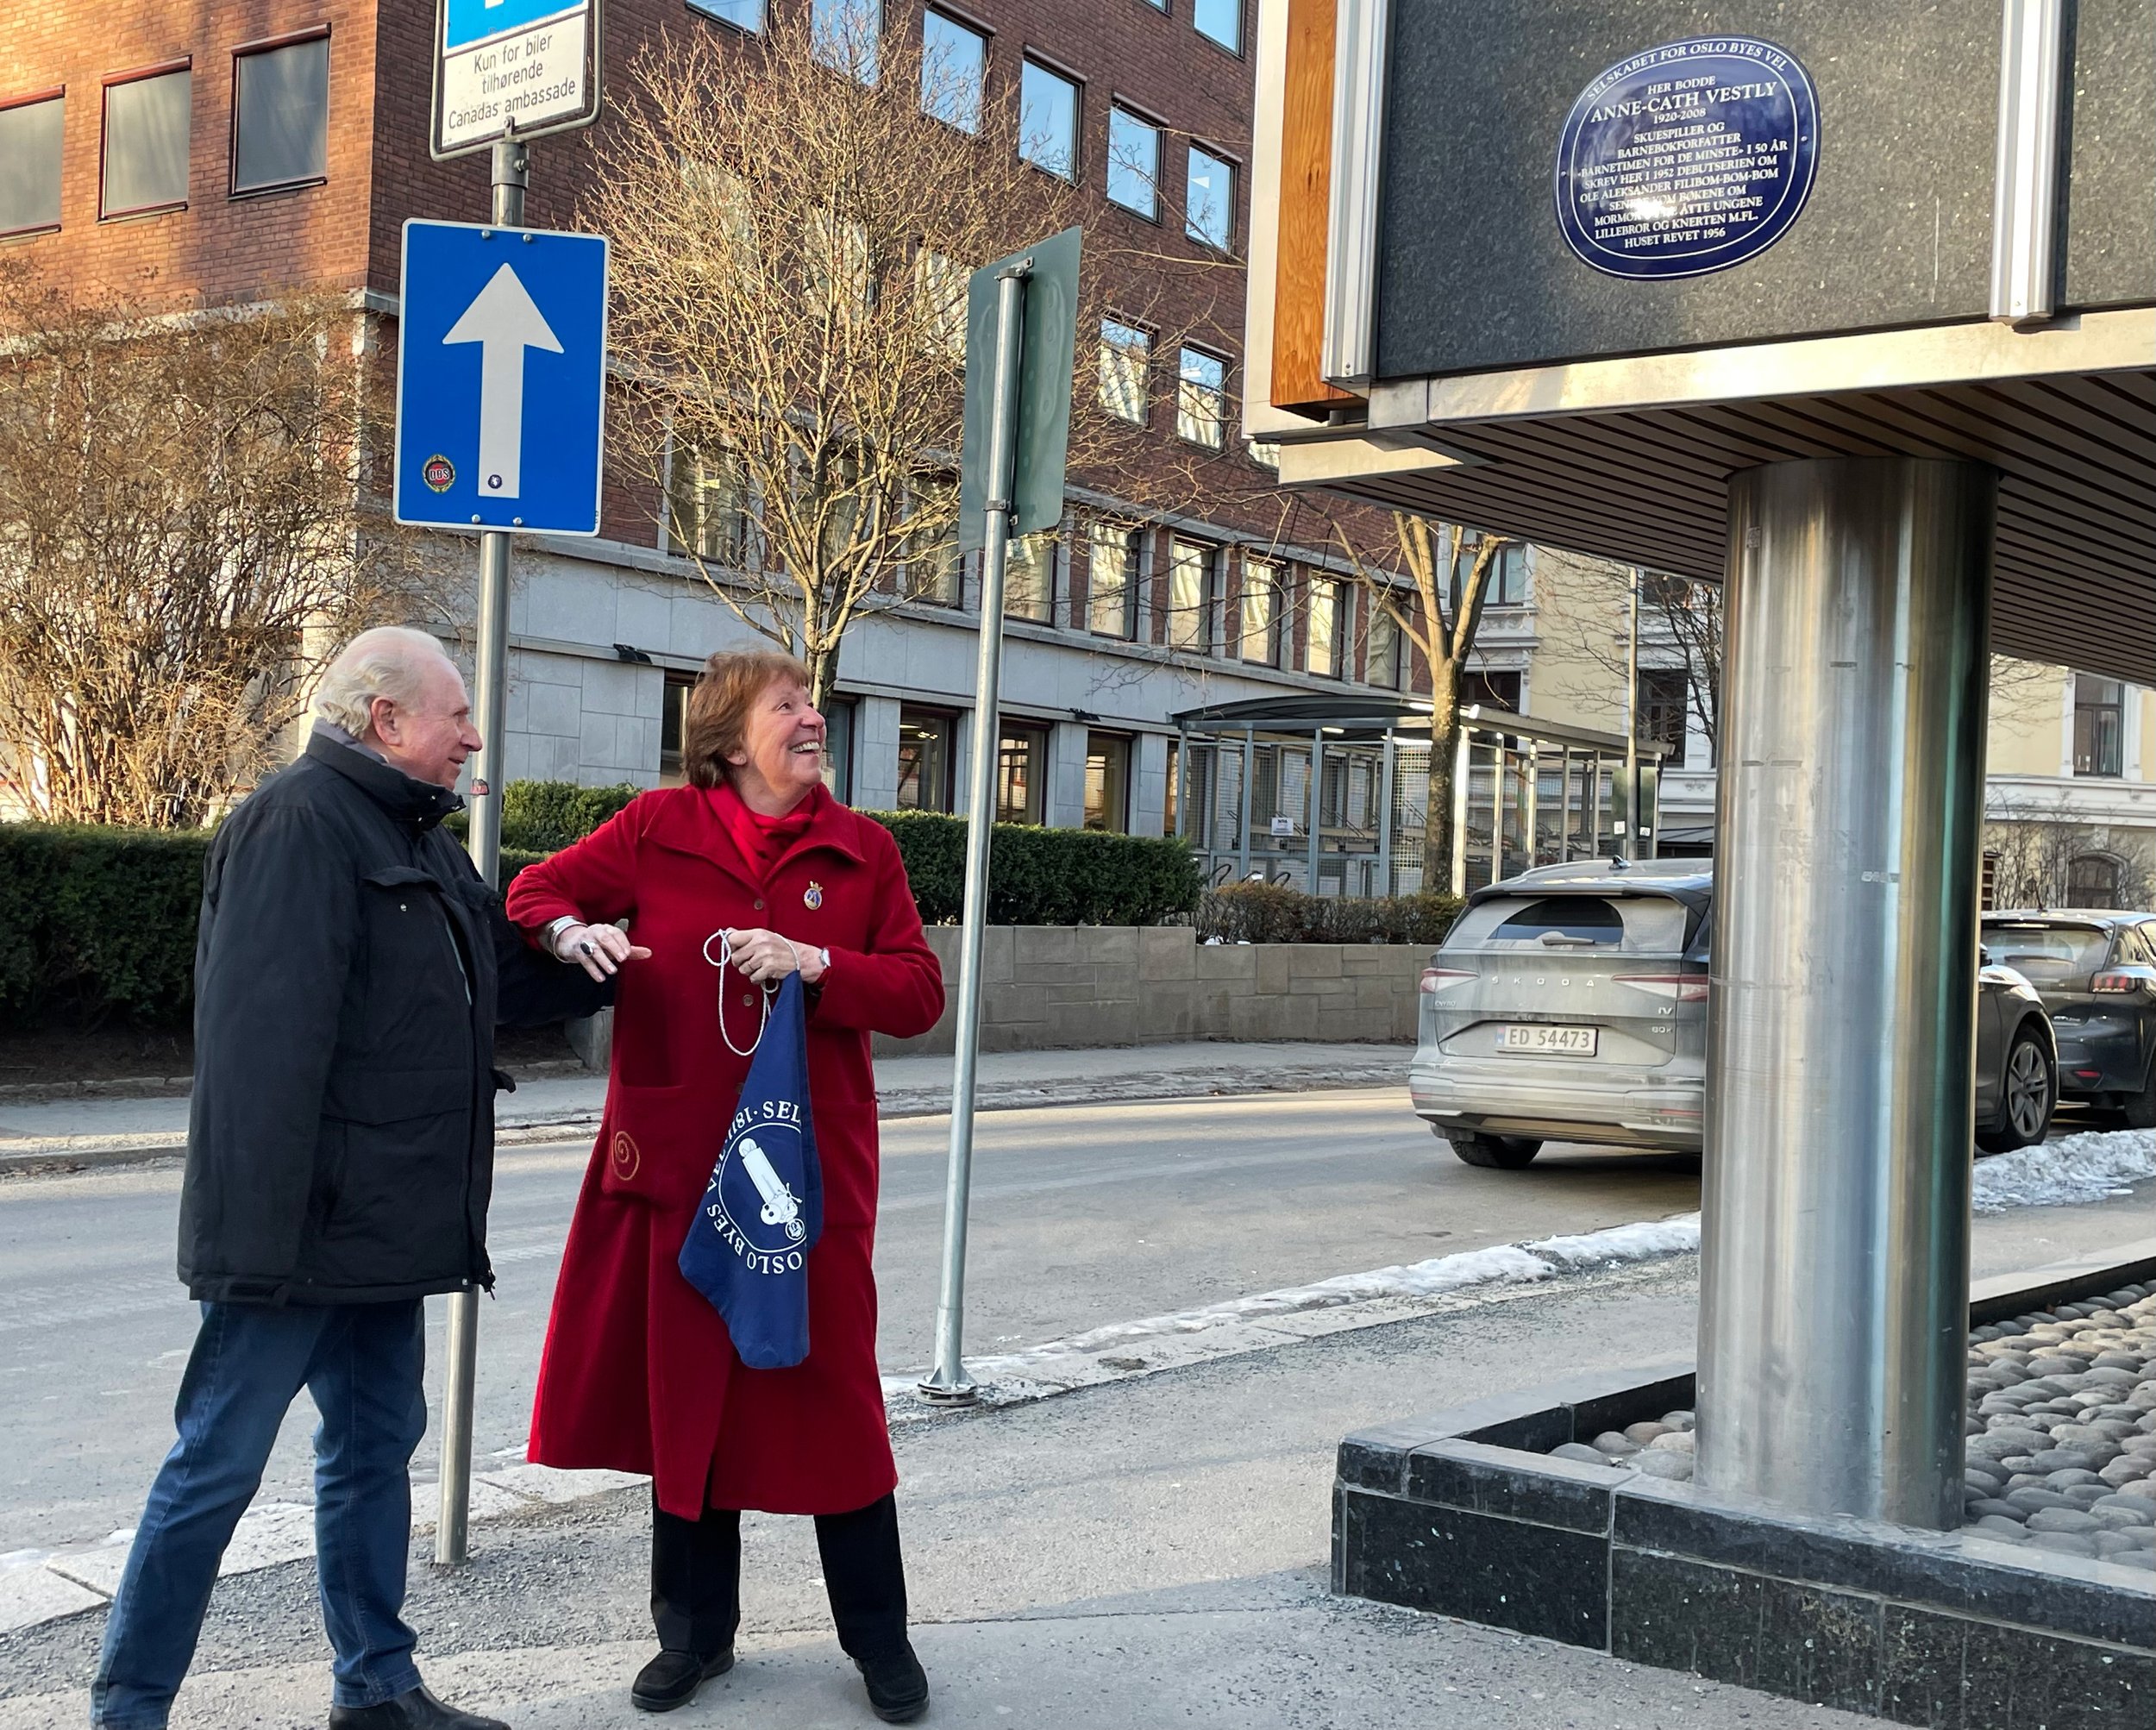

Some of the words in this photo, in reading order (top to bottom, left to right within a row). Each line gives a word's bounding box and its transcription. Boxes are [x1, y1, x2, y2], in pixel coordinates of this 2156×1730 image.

[474, 53, 497, 74] Kun
[503, 45, 520, 65] for
[526, 34, 553, 56] biler
[482, 60, 543, 94] tilhørende
[1587, 53, 1658, 101] SELSKABET
[1660, 46, 1687, 60] FOR
[1690, 42, 1727, 54] OSLO
[1729, 42, 1764, 58] BYES
[1765, 50, 1788, 72] VEL
[1647, 82, 1671, 95] HER
[1675, 76, 1716, 90] BODDE
[448, 102, 498, 129] Canadas
[505, 77, 576, 113] ambassade
[1590, 91, 1699, 122] ANNE-CATH
[1706, 82, 1777, 103] VESTLY
[1654, 108, 1707, 124] 1920-2008
[1618, 133, 1741, 159] BARNEBOKFORFATTER
[1634, 125, 1705, 144] SKUESPILLER
[1708, 122, 1725, 133] OG
[1653, 156, 1675, 167] FOR
[1677, 152, 1693, 164] DE
[1747, 144, 1752, 154] I
[1755, 143, 1768, 154] 50
[1771, 139, 1788, 152] ÅR
[1580, 192, 1599, 204] OLE
[1601, 181, 1671, 199] ALEKSANDER
[1675, 168, 1778, 190] FILIBOM-BOM-BOM
[1585, 175, 1618, 189] SKREV
[1620, 172, 1643, 184] HER
[1645, 172, 1650, 181] I
[1654, 168, 1674, 179] 1952
[1677, 157, 1755, 176] DEBUTSERIEN
[1758, 155, 1777, 166] OM
[1609, 197, 1649, 211] SEN
[1680, 187, 1725, 202] BØKENE
[1727, 185, 1746, 196] OM
[1680, 203, 1710, 216] ÅTTE
[1714, 197, 1763, 211] UNGENE
[1595, 223, 1650, 239] LILLEBROR
[1652, 221, 1669, 231] OG
[1672, 213, 1726, 229] KNERTEN
[1728, 210, 1758, 223] M.FL.
[1625, 235, 1660, 248] HUSET
[1663, 230, 1700, 243] REVET
[1703, 228, 1726, 239] 1956
[1509, 1029, 1530, 1044] ED
[1538, 1030, 1589, 1048] 54473
[707, 1204, 745, 1256] BYES
[747, 1251, 802, 1274] OSLO
